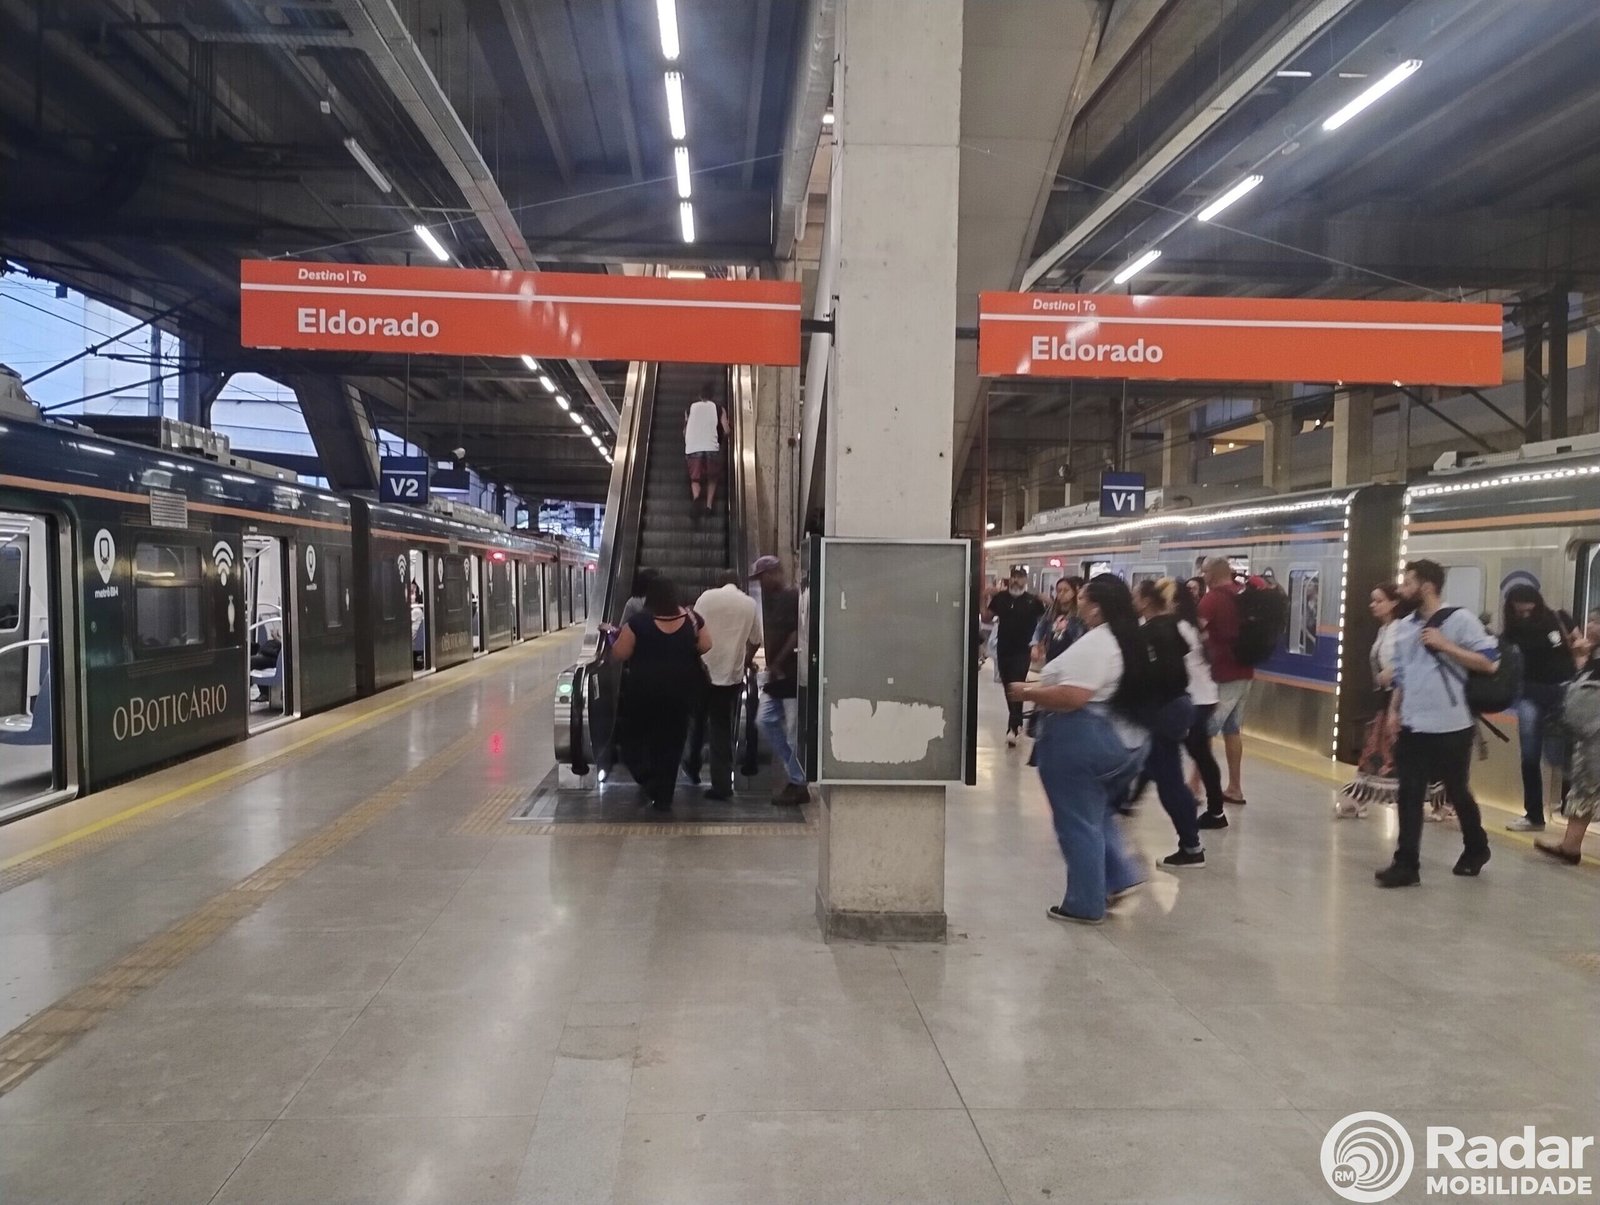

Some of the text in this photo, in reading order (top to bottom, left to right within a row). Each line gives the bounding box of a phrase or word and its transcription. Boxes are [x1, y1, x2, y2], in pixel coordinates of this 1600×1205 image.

[298, 268, 367, 282] Destino To
[1033, 298, 1096, 312] Destino To
[298, 307, 440, 338] Eldorado
[1032, 336, 1163, 363] Eldorado
[390, 478, 419, 497] V2
[1111, 492, 1136, 512] V1
